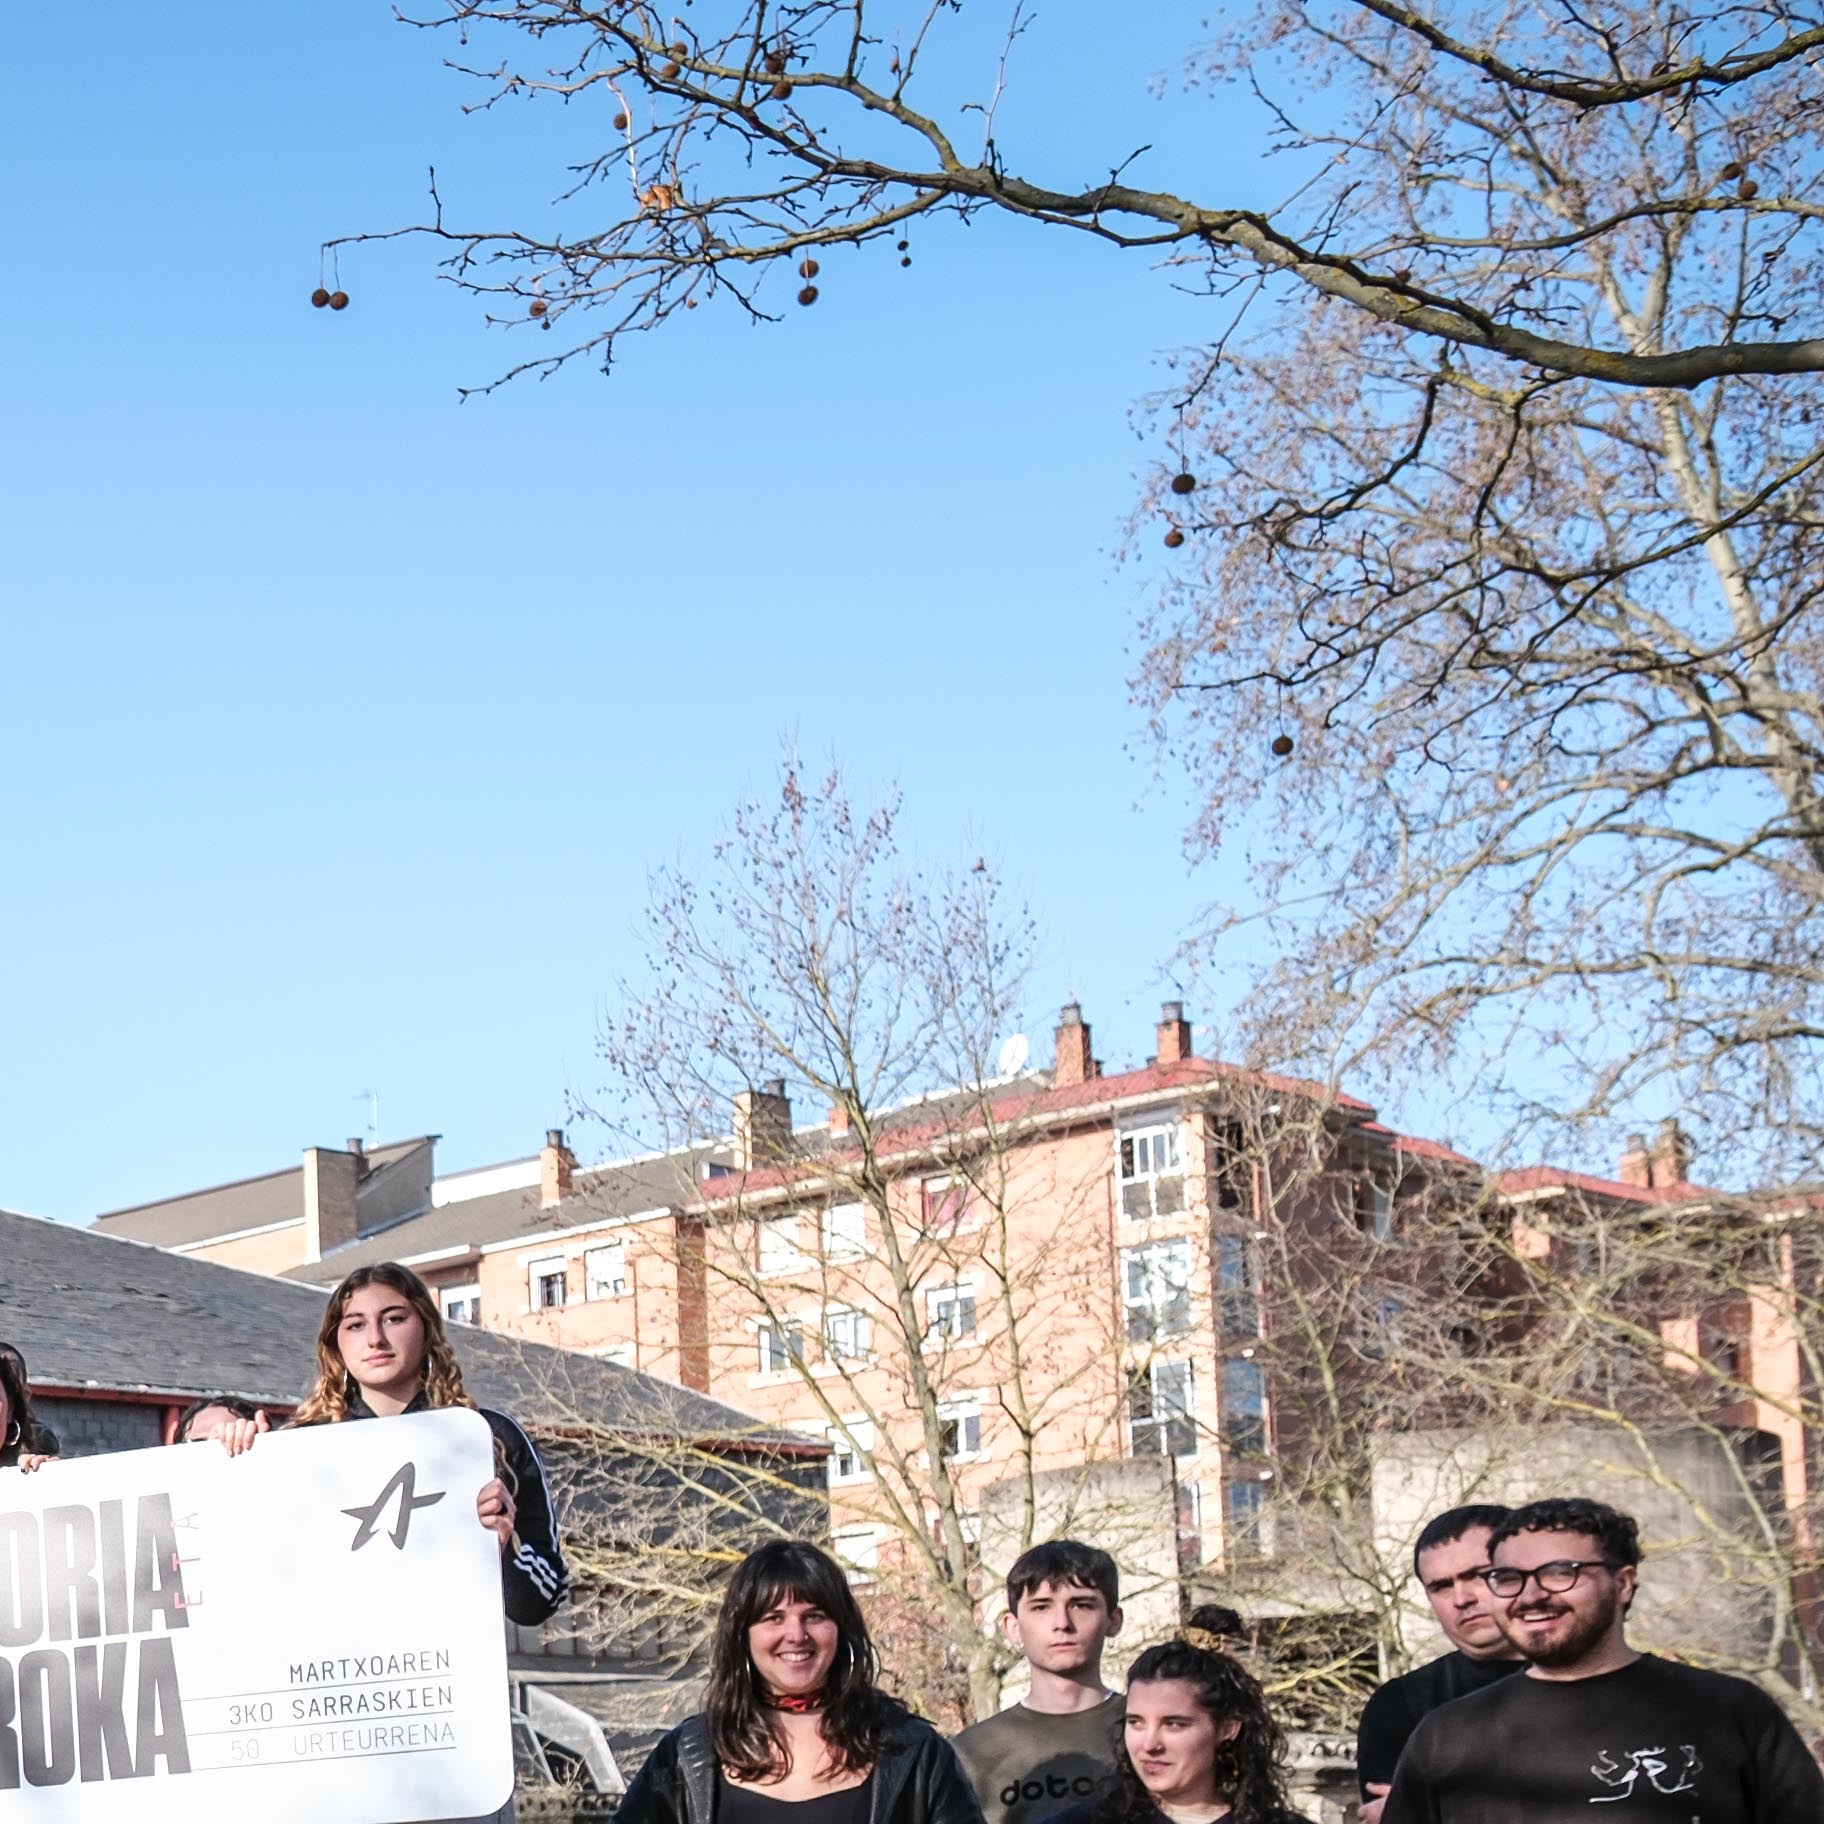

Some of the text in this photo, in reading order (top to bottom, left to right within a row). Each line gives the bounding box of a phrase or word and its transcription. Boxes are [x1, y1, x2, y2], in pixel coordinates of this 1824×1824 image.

[170, 1512, 203, 1609] ETA
[289, 1649, 450, 1684] MARTXOAREN
[228, 1685, 453, 1726] 3KO SARRASKIEN
[293, 1721, 456, 1756] URTEURRENA
